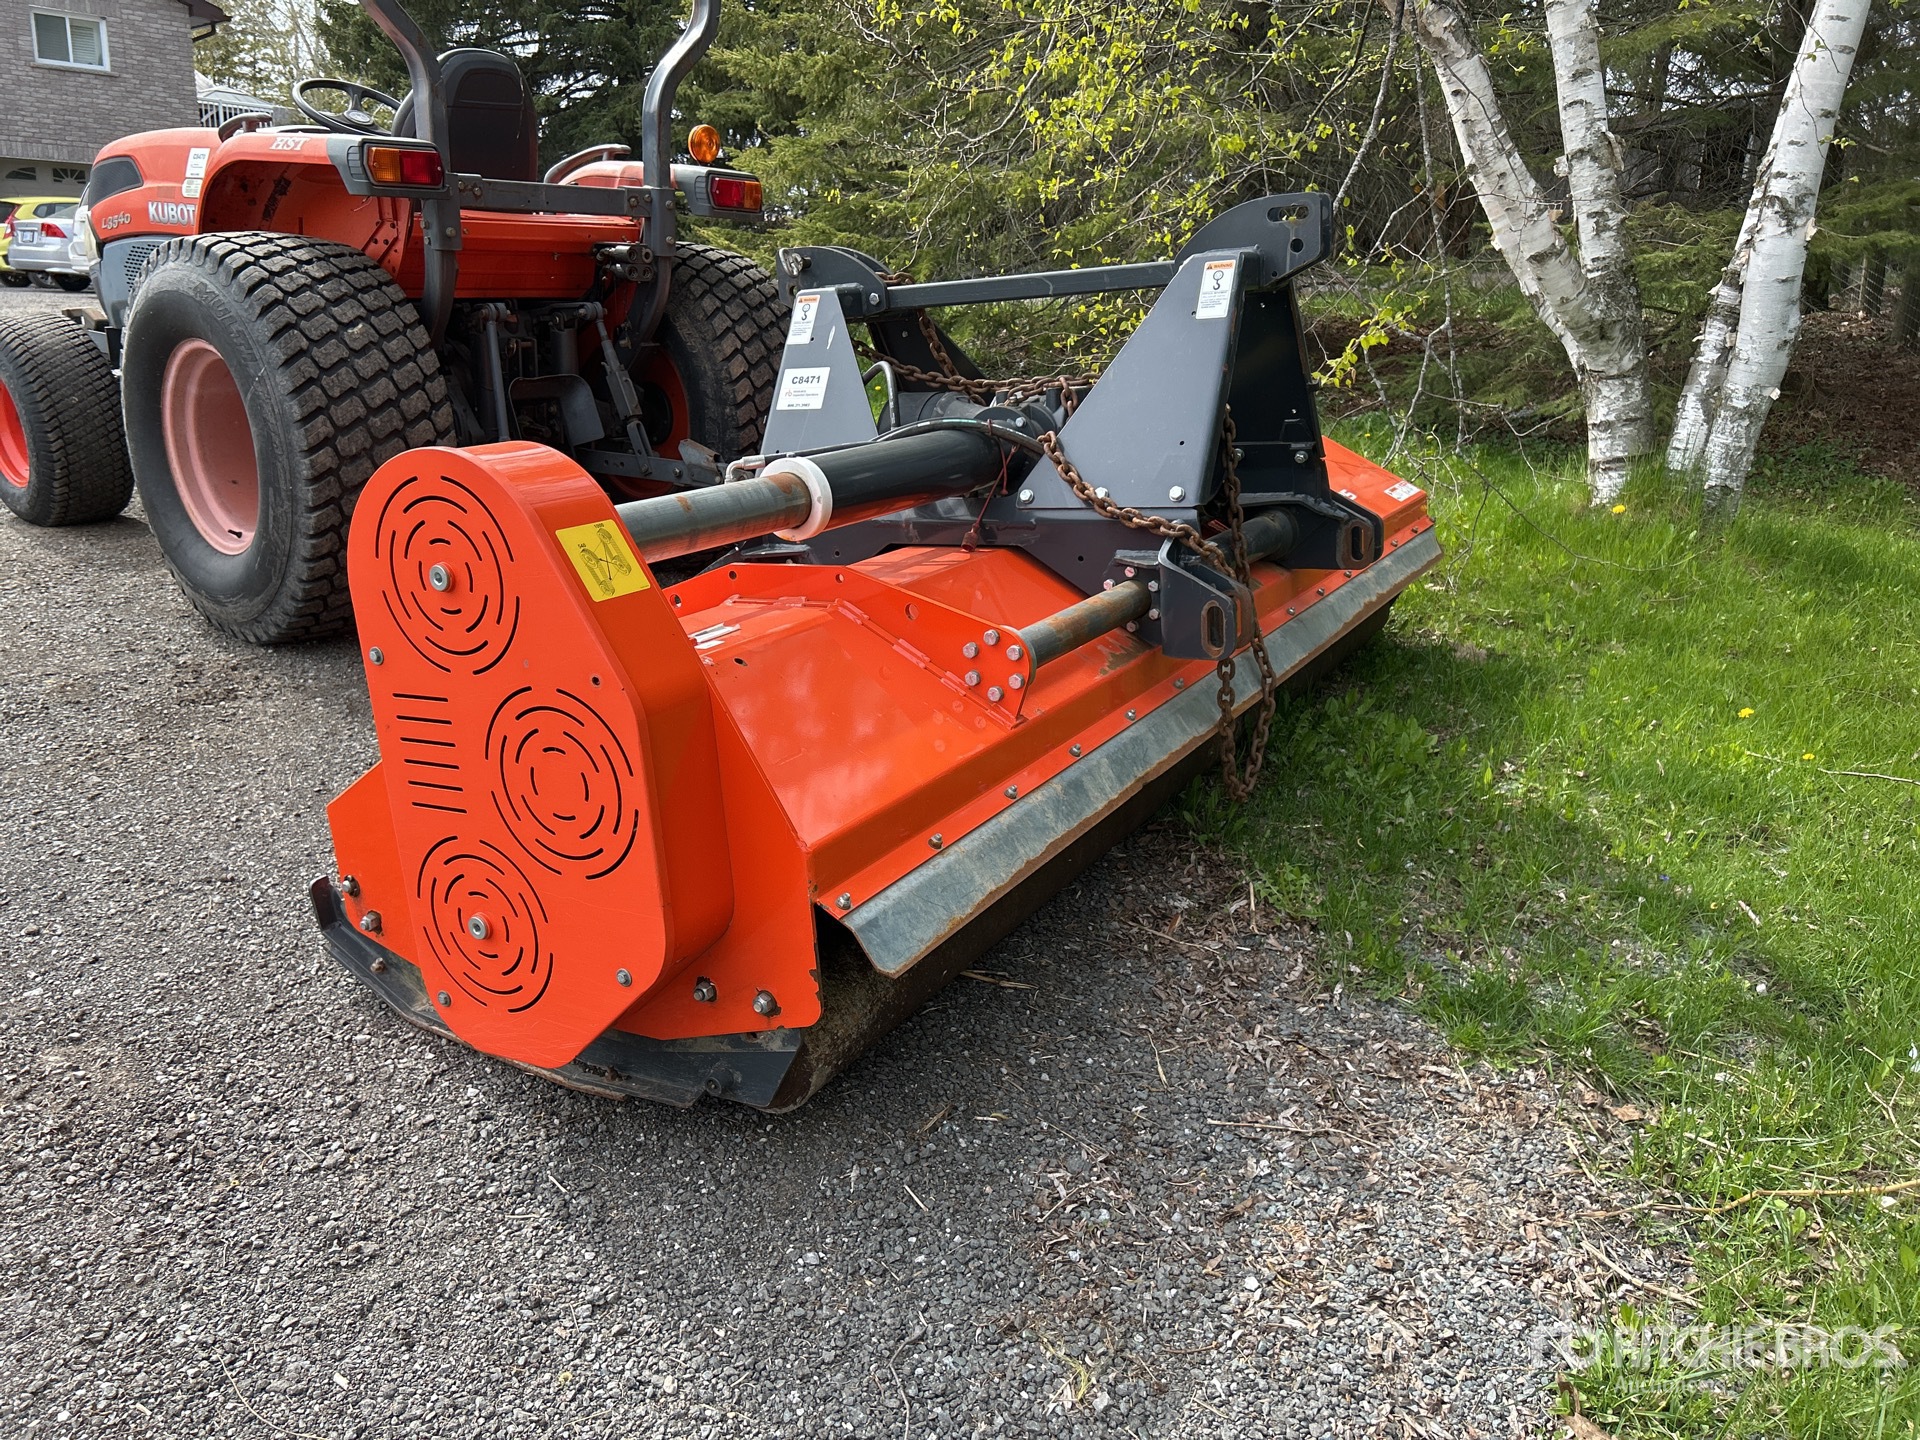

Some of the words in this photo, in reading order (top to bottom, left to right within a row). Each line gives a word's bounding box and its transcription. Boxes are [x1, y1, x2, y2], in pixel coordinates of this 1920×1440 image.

[269, 136, 311, 151] HST
[101, 211, 132, 230] L3540
[148, 201, 196, 226] KUBOT
[791, 375, 821, 385] C8471
